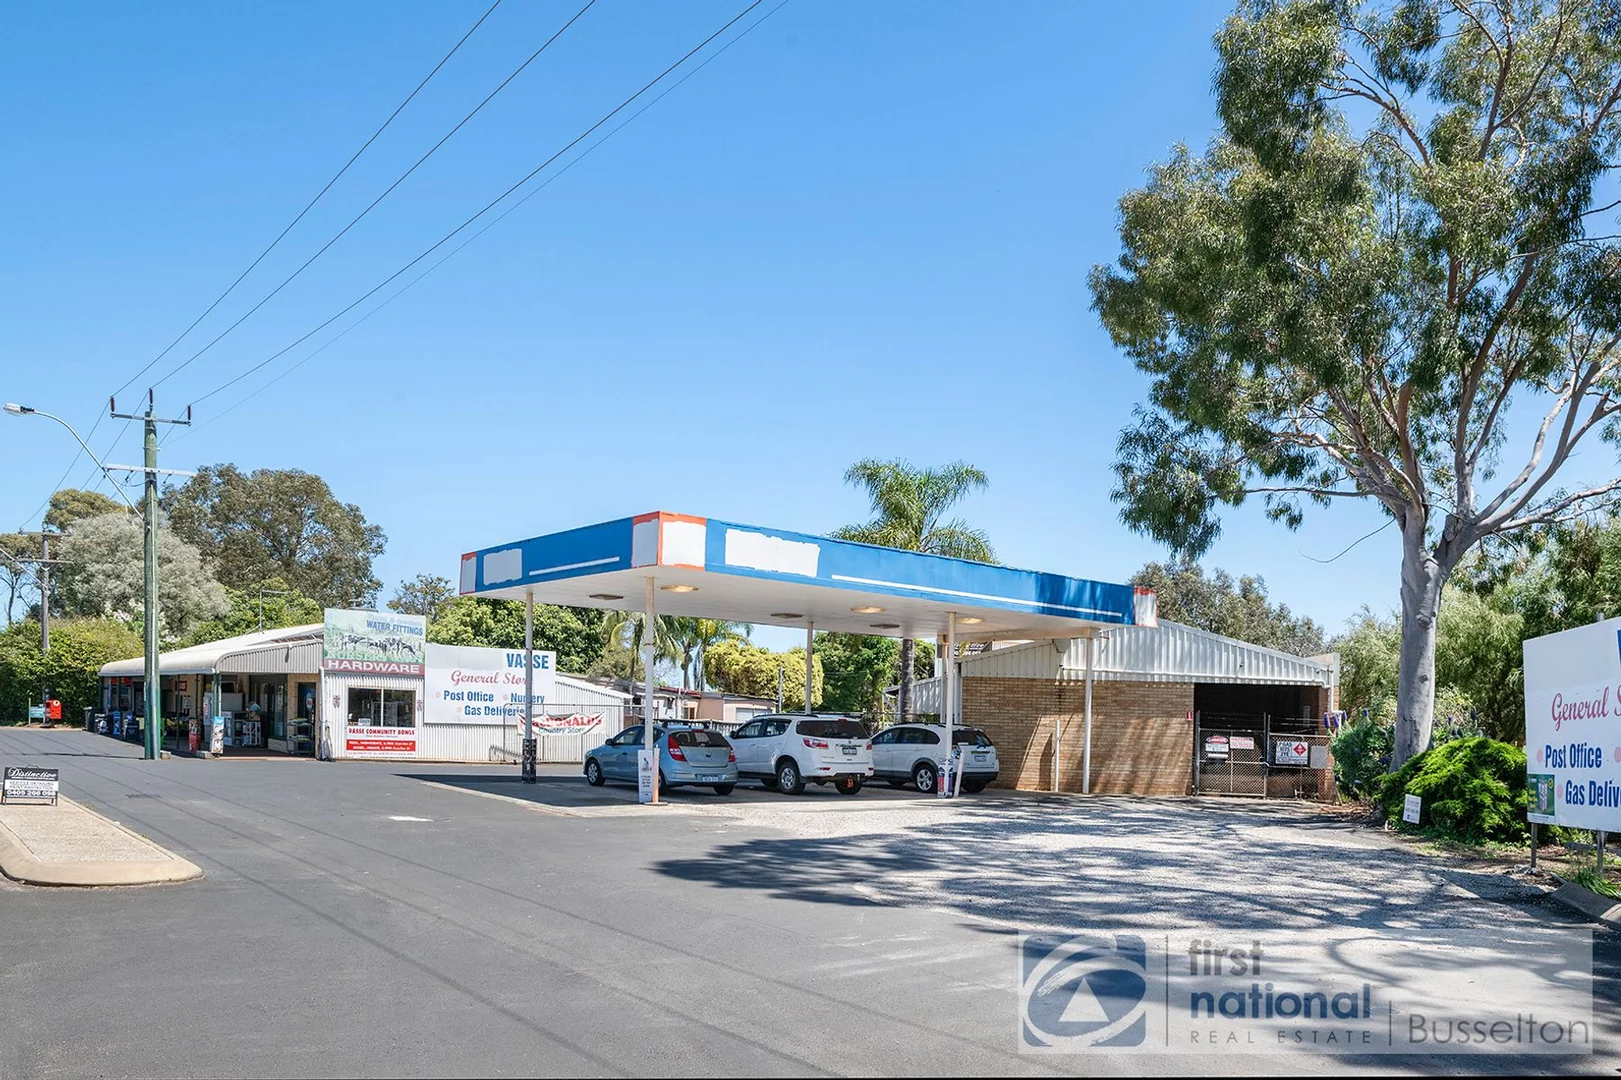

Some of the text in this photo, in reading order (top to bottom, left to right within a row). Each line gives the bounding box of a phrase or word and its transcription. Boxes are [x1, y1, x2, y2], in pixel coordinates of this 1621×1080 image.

[366, 619, 391, 631] WATER
[392, 624, 424, 636] FITTINGS
[327, 659, 420, 673] HARDWARE
[506, 653, 549, 669] VASE
[450, 669, 533, 686] General Stor
[444, 690, 494, 702] Post Office
[510, 693, 545, 704] Nurery
[464, 705, 482, 716] Gas
[1551, 686, 1610, 732] General
[1545, 742, 1602, 768] Post Office
[7, 767, 57, 778] Distinctive
[1565, 779, 1585, 806] Gas
[1588, 779, 1621, 808] Deliv
